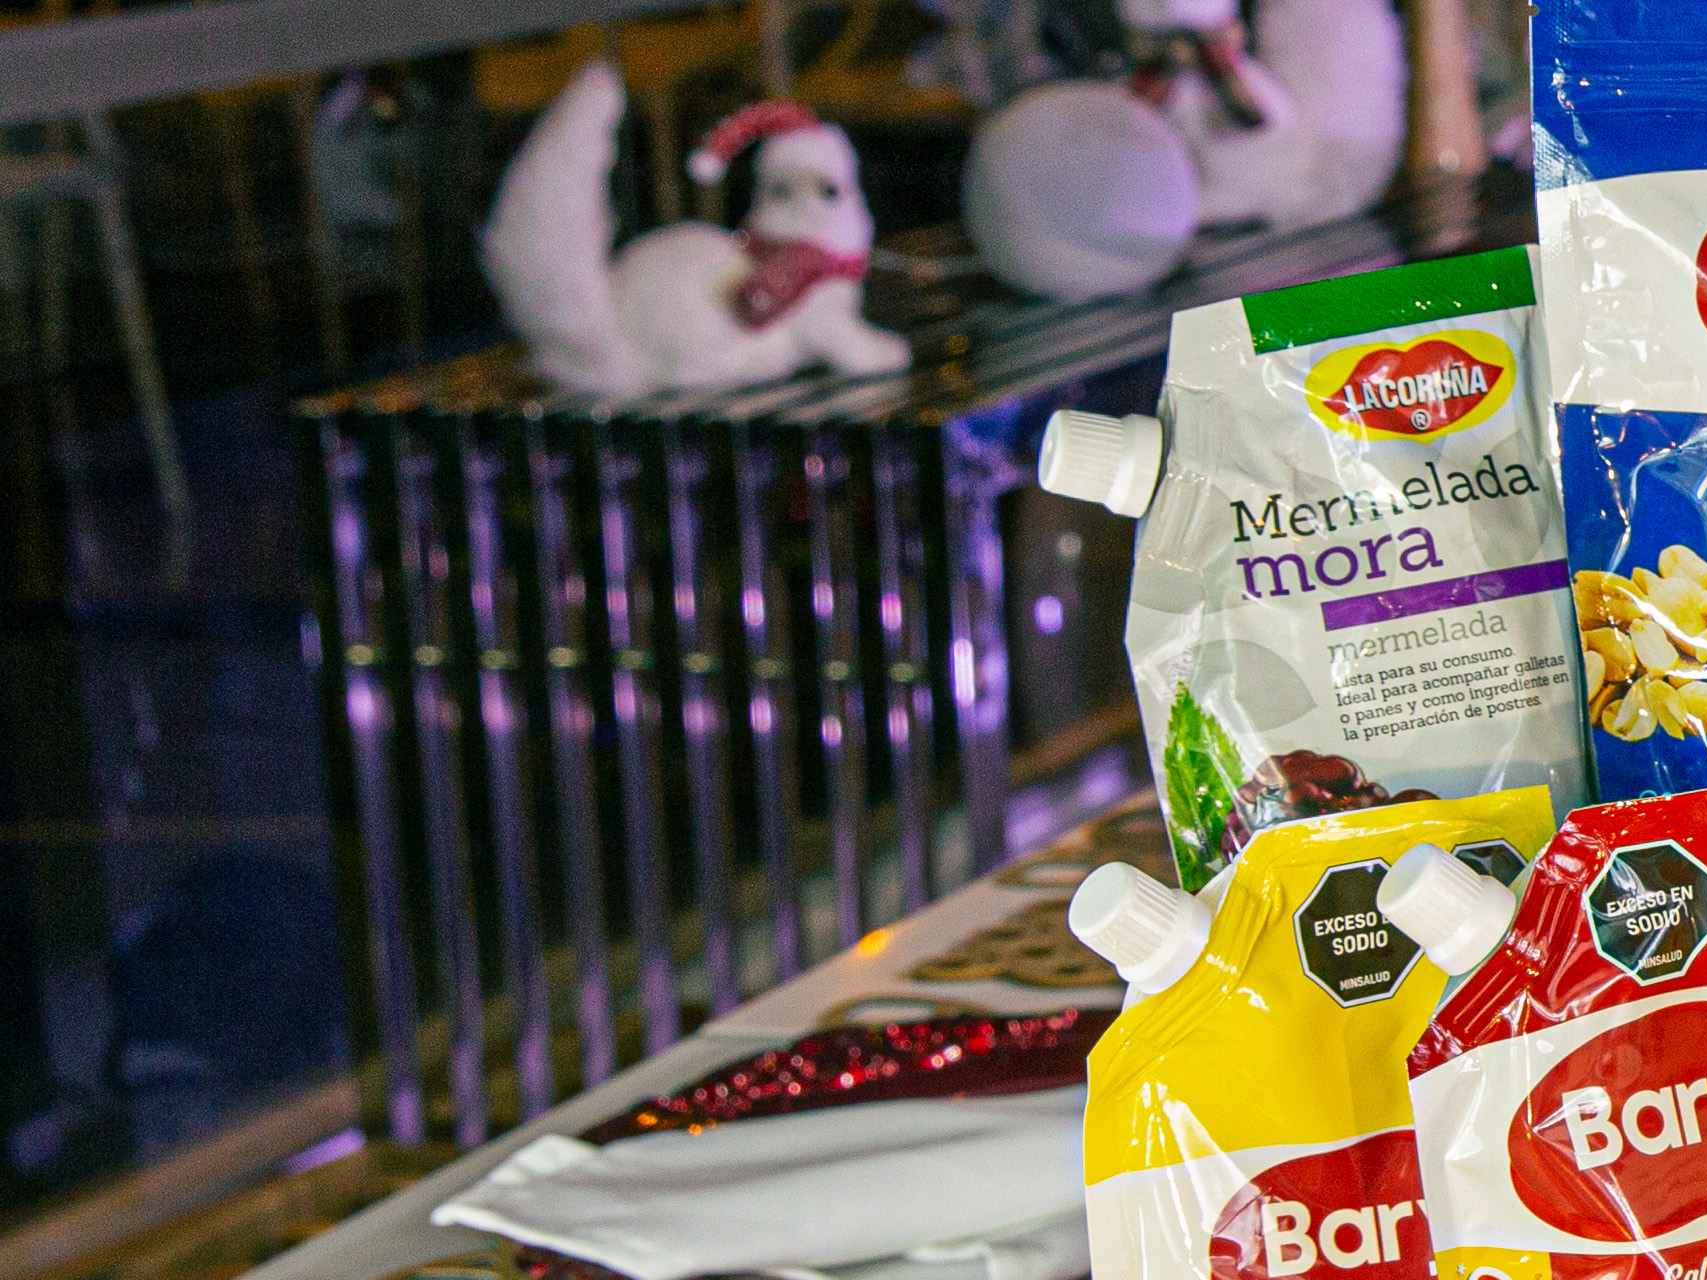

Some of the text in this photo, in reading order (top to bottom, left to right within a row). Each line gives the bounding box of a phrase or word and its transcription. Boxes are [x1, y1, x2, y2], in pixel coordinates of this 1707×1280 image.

[1231, 455, 1540, 543] Mermelada
[1237, 525, 1443, 601] mora
[1327, 611, 1507, 662] mermelada
[1336, 654, 1565, 707] Ideal para acompañar galletas
[1380, 664, 1415, 684] para
[1419, 660, 1437, 674] su
[1340, 672, 1569, 726] o panes y como ingrediente en
[1343, 695, 1541, 741] la preparación de postres.
[1606, 884, 1694, 918] EXCESO EN
[1314, 912, 1377, 936] EXCESO
[1626, 907, 1681, 937] SODIO
[1332, 930, 1388, 955] SODIO
[1639, 949, 1683, 970] MINSALUD
[1340, 971, 1390, 991] MINSALUD
